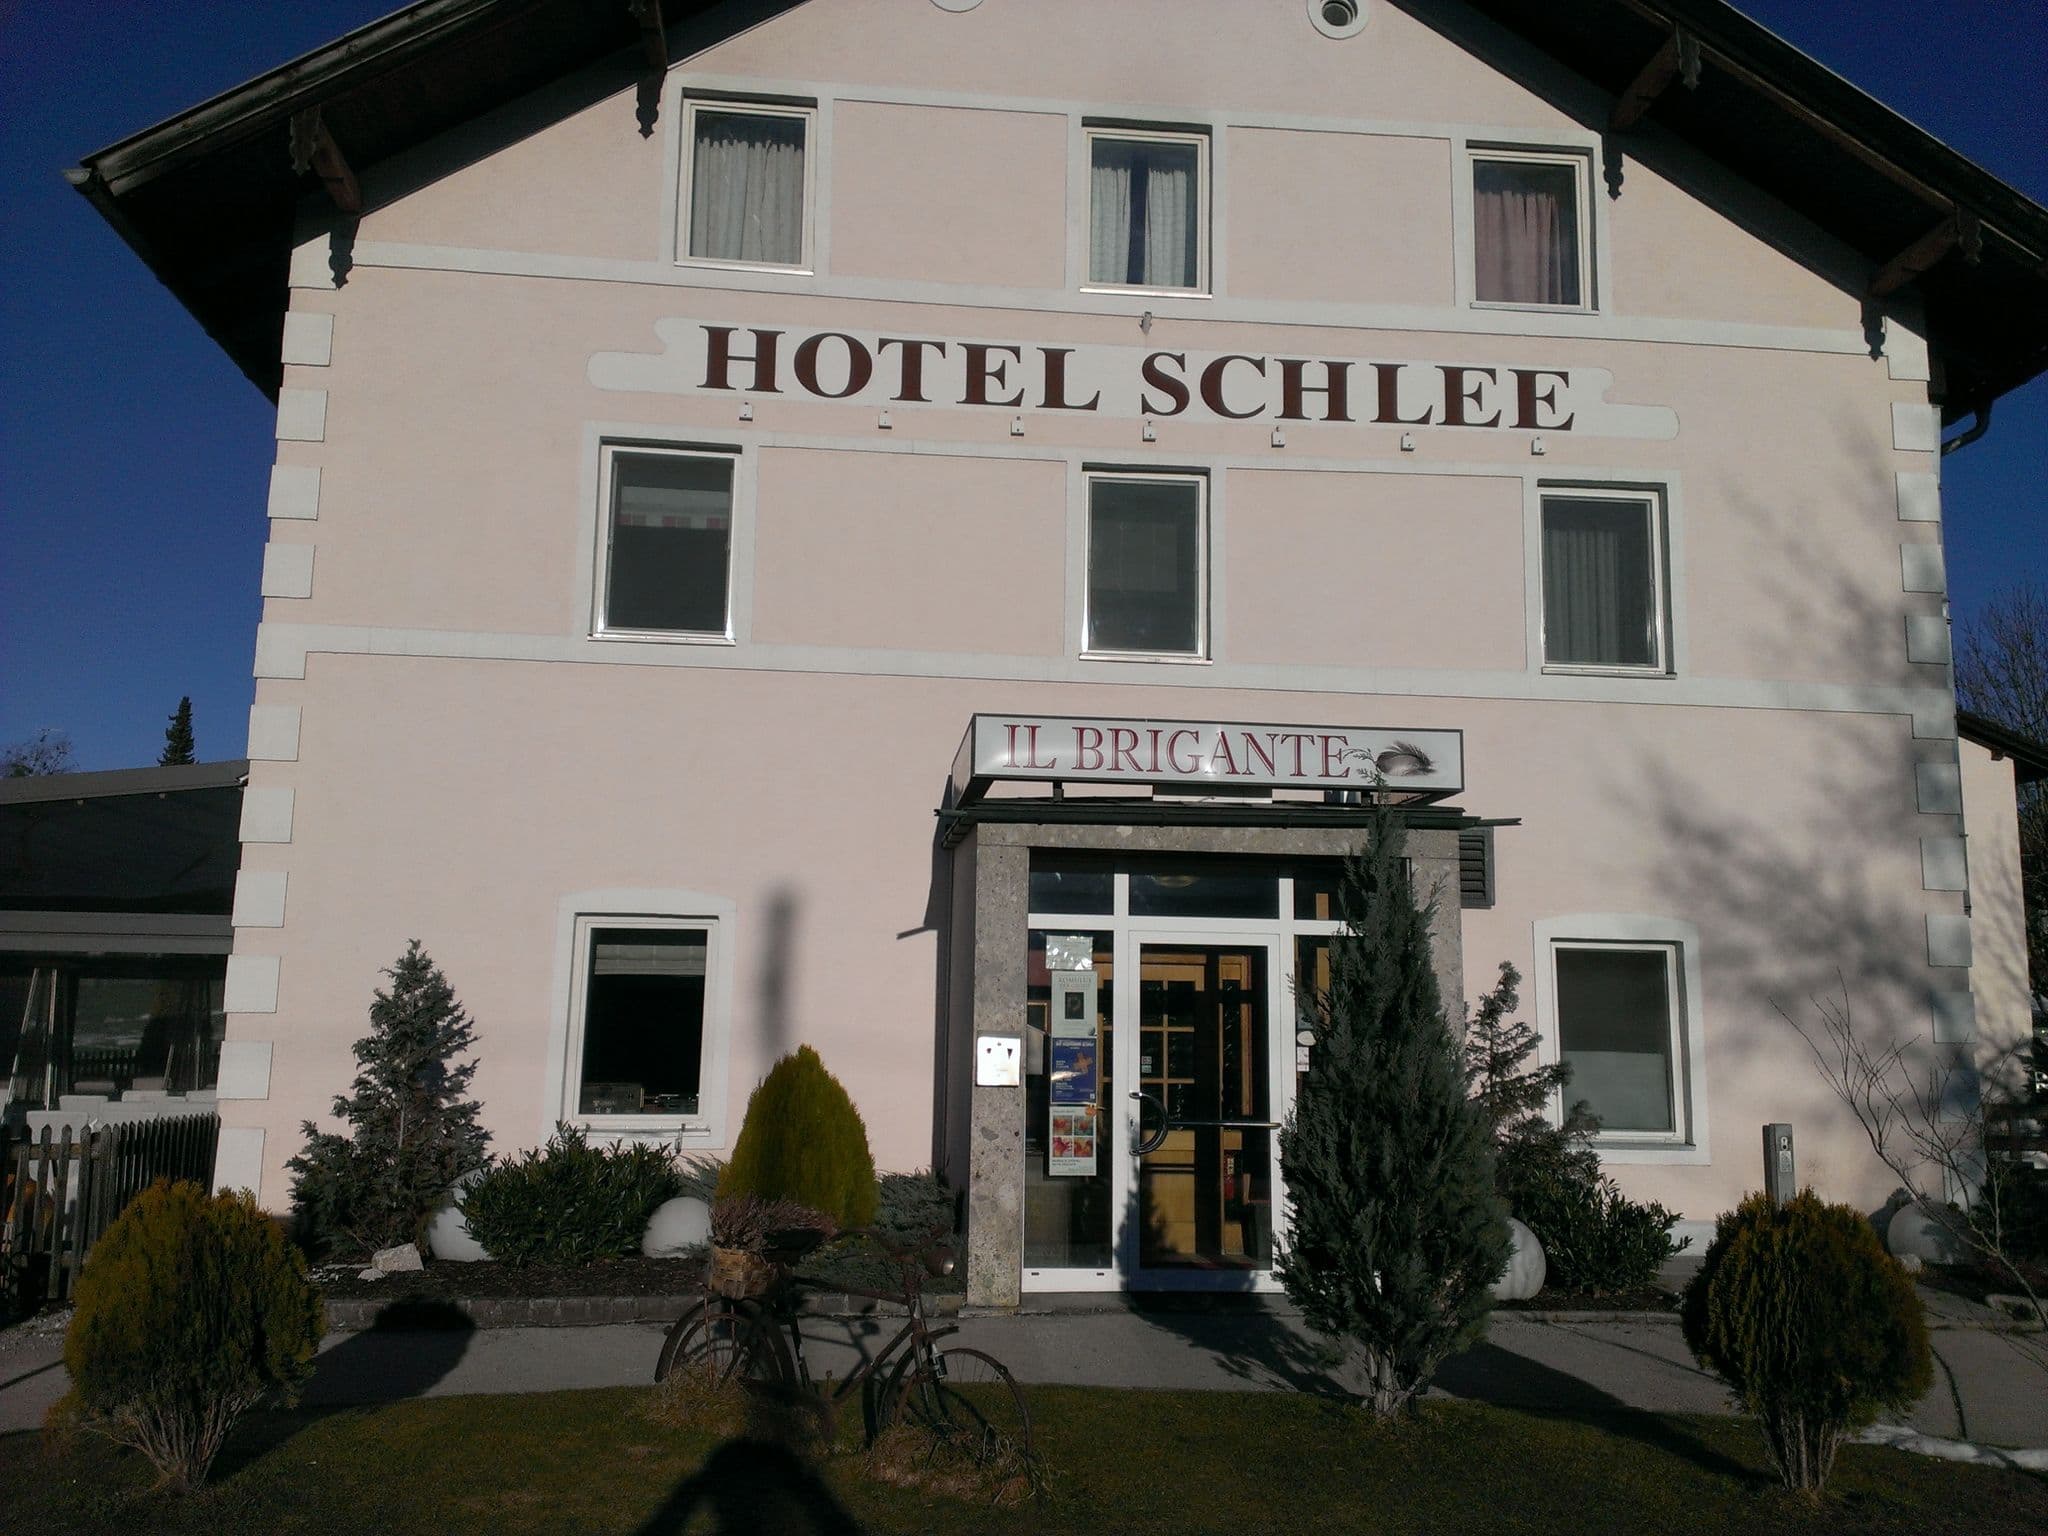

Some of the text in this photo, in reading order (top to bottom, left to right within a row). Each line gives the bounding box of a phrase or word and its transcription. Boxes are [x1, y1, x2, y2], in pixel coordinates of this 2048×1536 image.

[697, 324, 1575, 432] HOTEL SCHLEE
[1003, 724, 1351, 778] IL BRIGANTE
